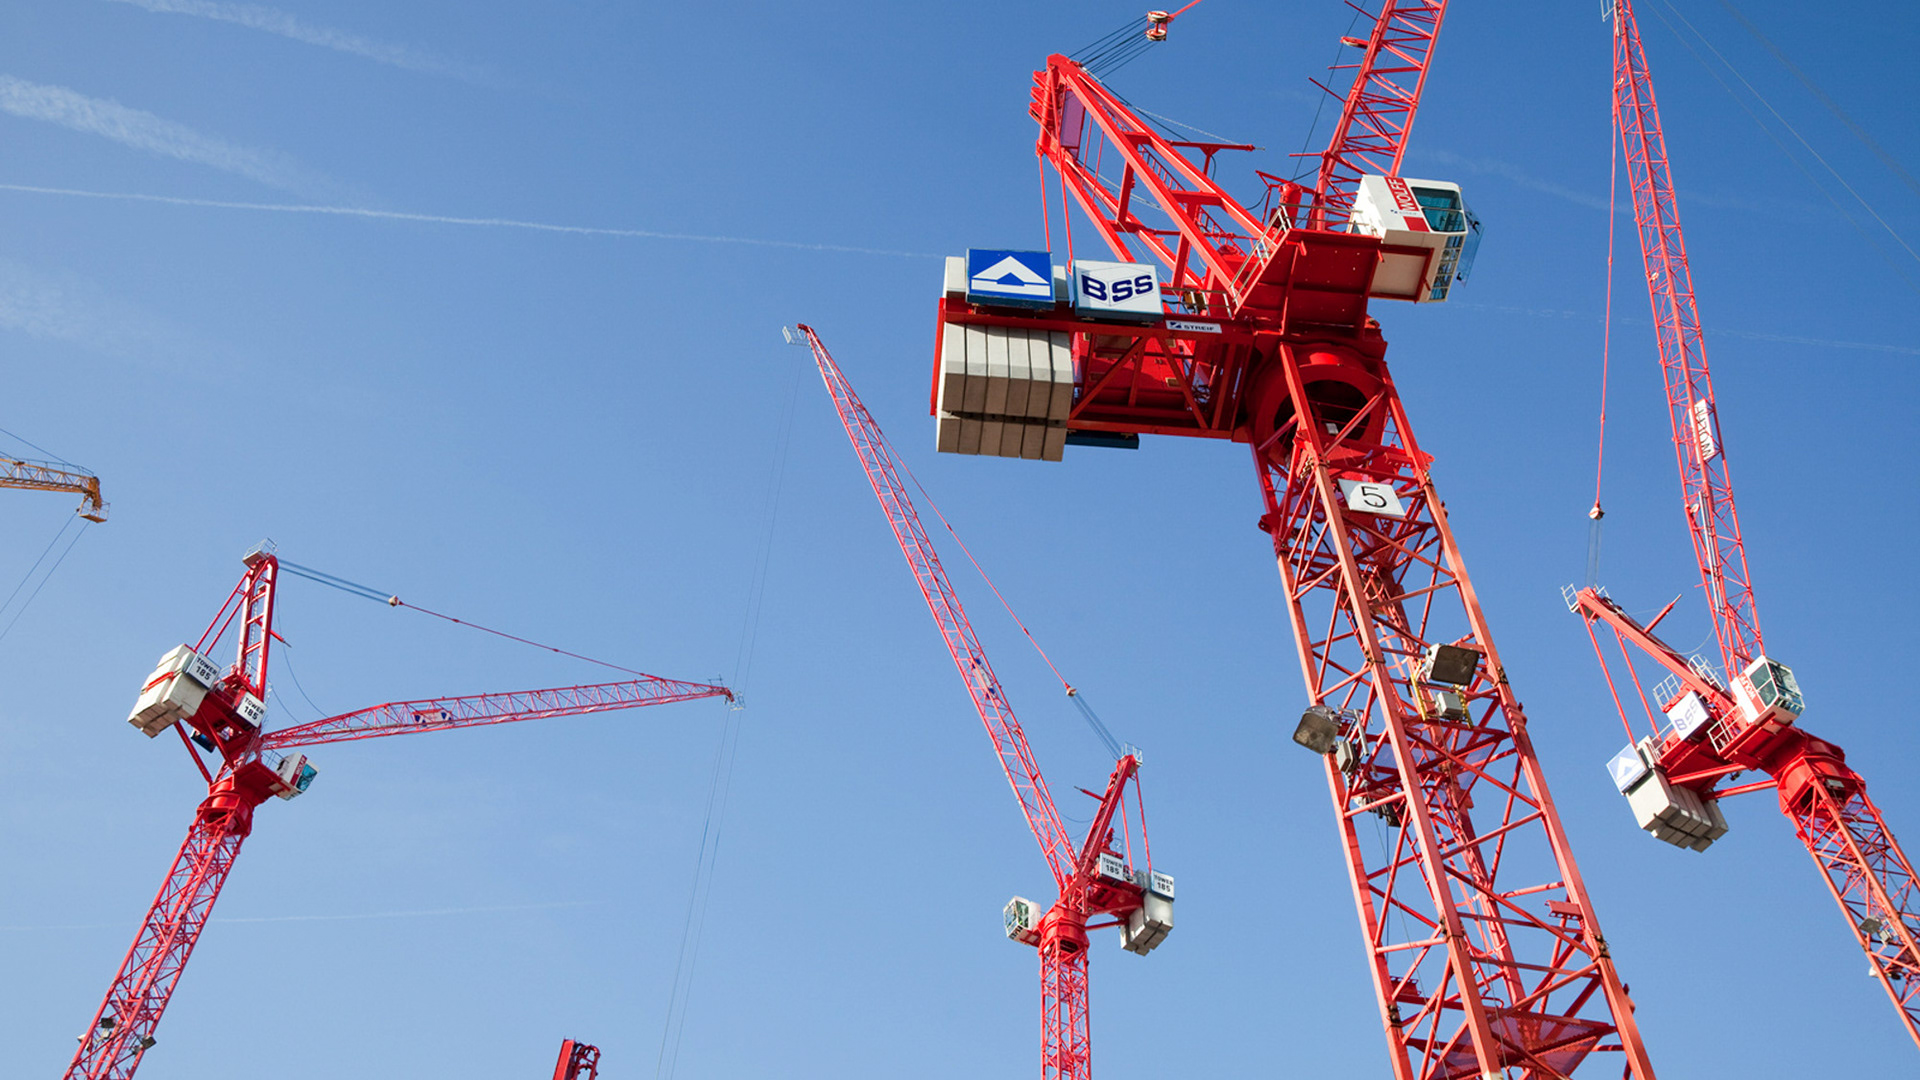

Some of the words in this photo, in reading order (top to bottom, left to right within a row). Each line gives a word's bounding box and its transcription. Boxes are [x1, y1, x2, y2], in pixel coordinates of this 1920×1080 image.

[1388, 178, 1416, 211] WOLFF
[1081, 274, 1153, 302] BSS
[1361, 486, 1387, 508] 5
[196, 666, 211, 680] 185
[197, 657, 217, 675] TOWER
[244, 706, 258, 720] 185
[245, 697, 264, 715] TOWER
[1674, 698, 1699, 731] BSS
[1103, 857, 1122, 868] TOWER
[1106, 864, 1120, 875] 185
[1154, 874, 1173, 885] TOWER
[1157, 882, 1171, 893] 185
